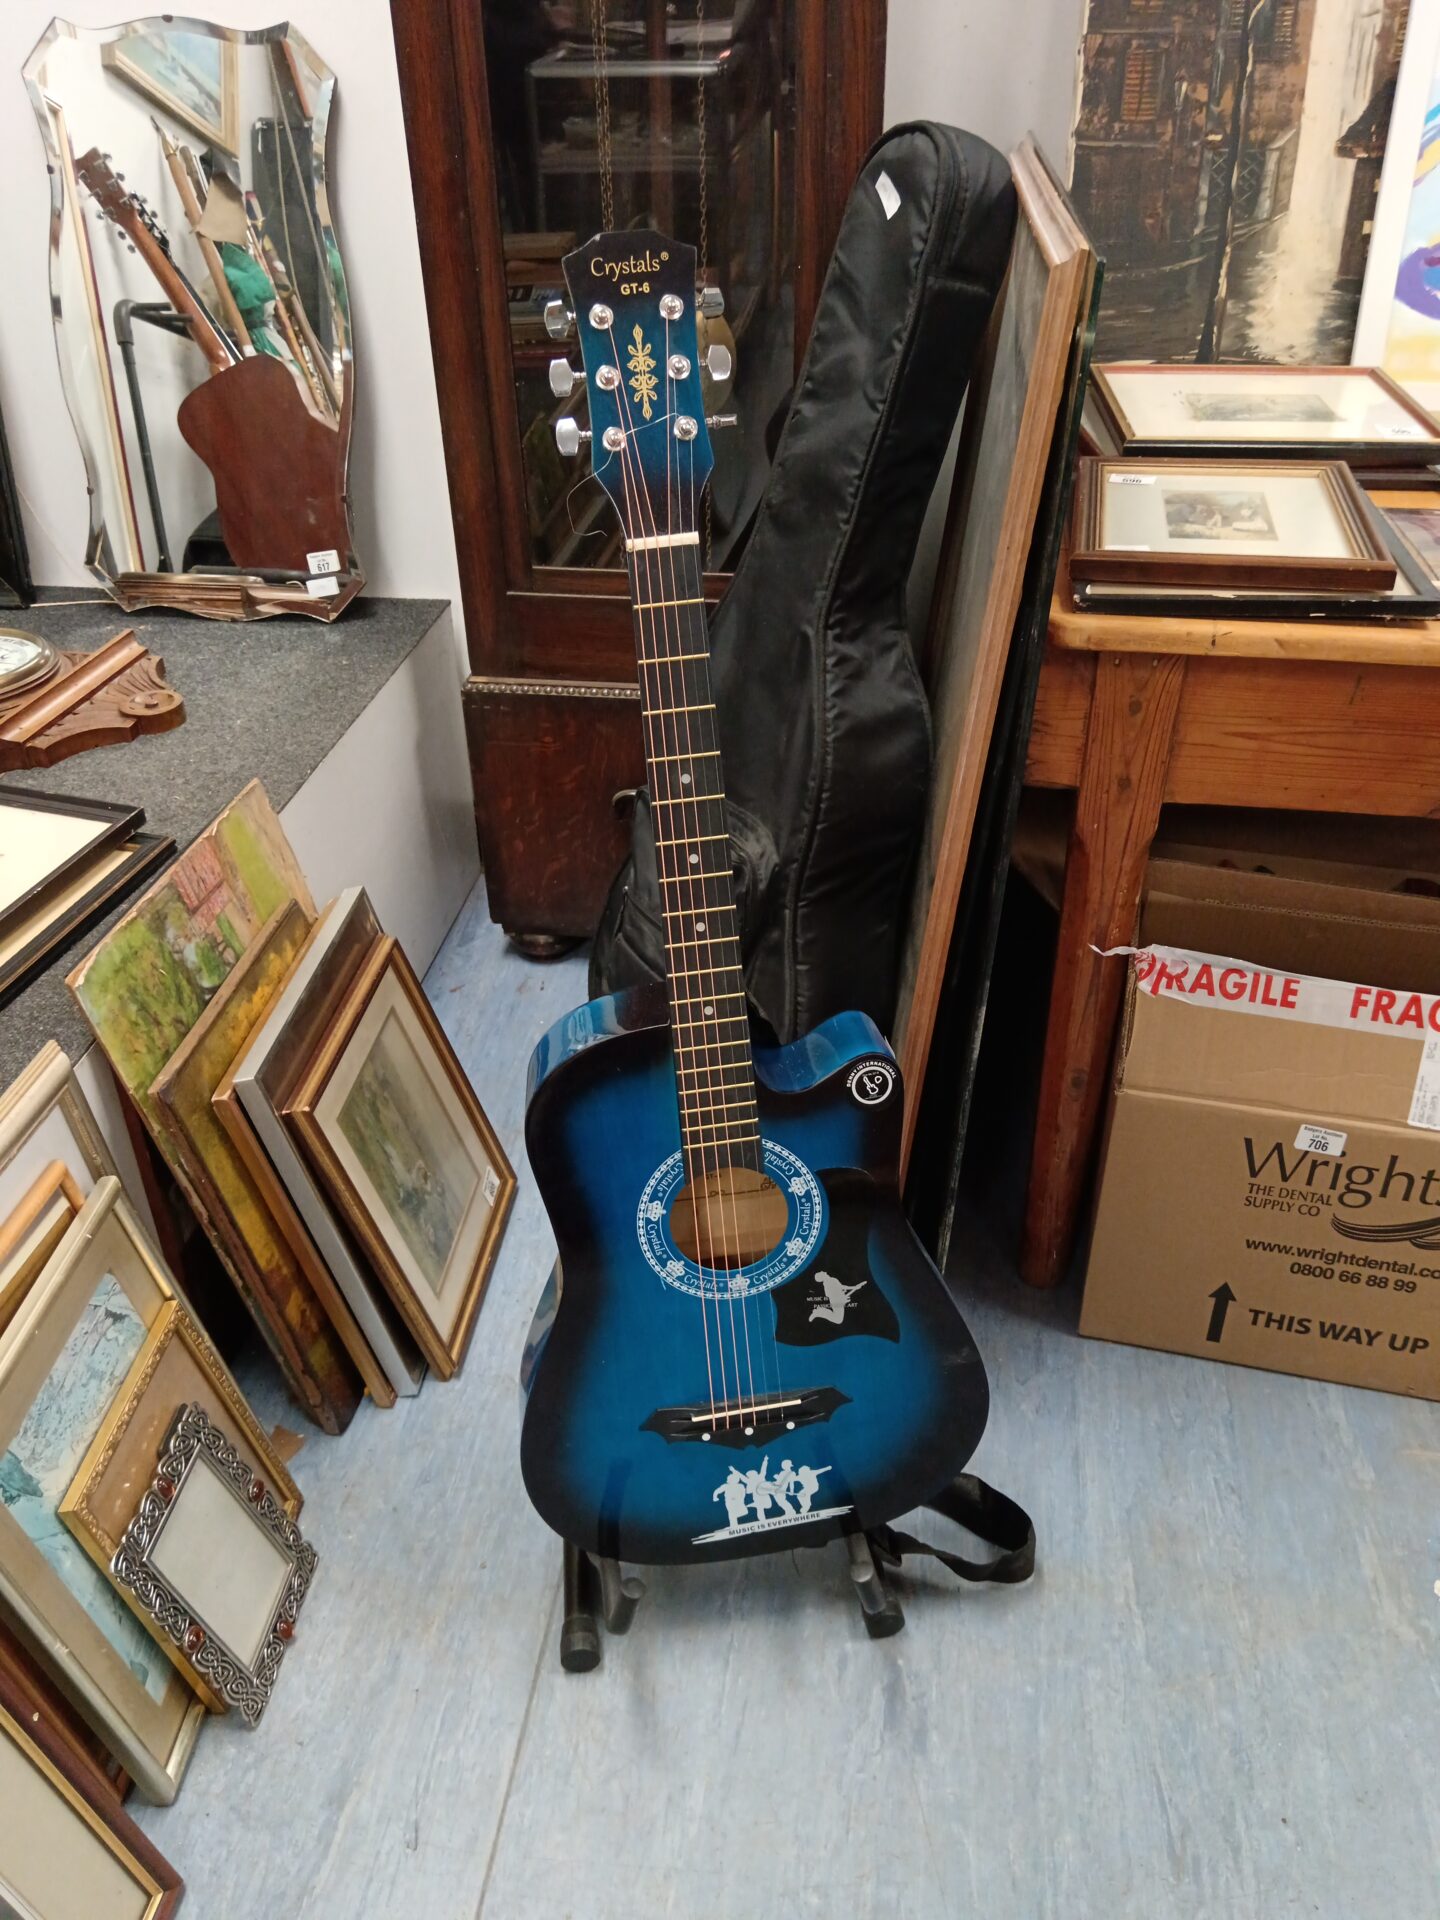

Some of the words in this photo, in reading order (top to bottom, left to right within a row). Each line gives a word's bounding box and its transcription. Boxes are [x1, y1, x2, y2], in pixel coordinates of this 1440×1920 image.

[620, 282, 650, 295] GT-6
[316, 562, 330, 572] 617
[857, 1061, 897, 1079] INTERNATIONAL
[1308, 1138, 1329, 1152] 706
[764, 1151, 795, 1175] Crystals
[1244, 1137, 1440, 1208] Wright
[657, 1162, 684, 1192] Crystals
[1244, 1195, 1296, 1213] SUPPLY
[1297, 1204, 1321, 1217] CO
[1248, 1182, 1276, 1197] THE
[1278, 1188, 1333, 1207] DENTAL
[800, 1202, 811, 1236] Crystals
[647, 1224, 665, 1257] Crystals
[753, 1262, 787, 1285] Crystals
[1290, 1262, 1335, 1280] 0800
[1338, 1270, 1362, 1285] 66
[1365, 1274, 1389, 1289] 88
[1393, 1279, 1417, 1294] 99
[1249, 1308, 1312, 1335] THIS
[1318, 1320, 1383, 1347] WAY
[1388, 1333, 1430, 1354] UP
[729, 1525, 756, 1536] MUSIC
[757, 1523, 766, 1531] IS
[767, 1512, 821, 1528] EVERYWHERE
